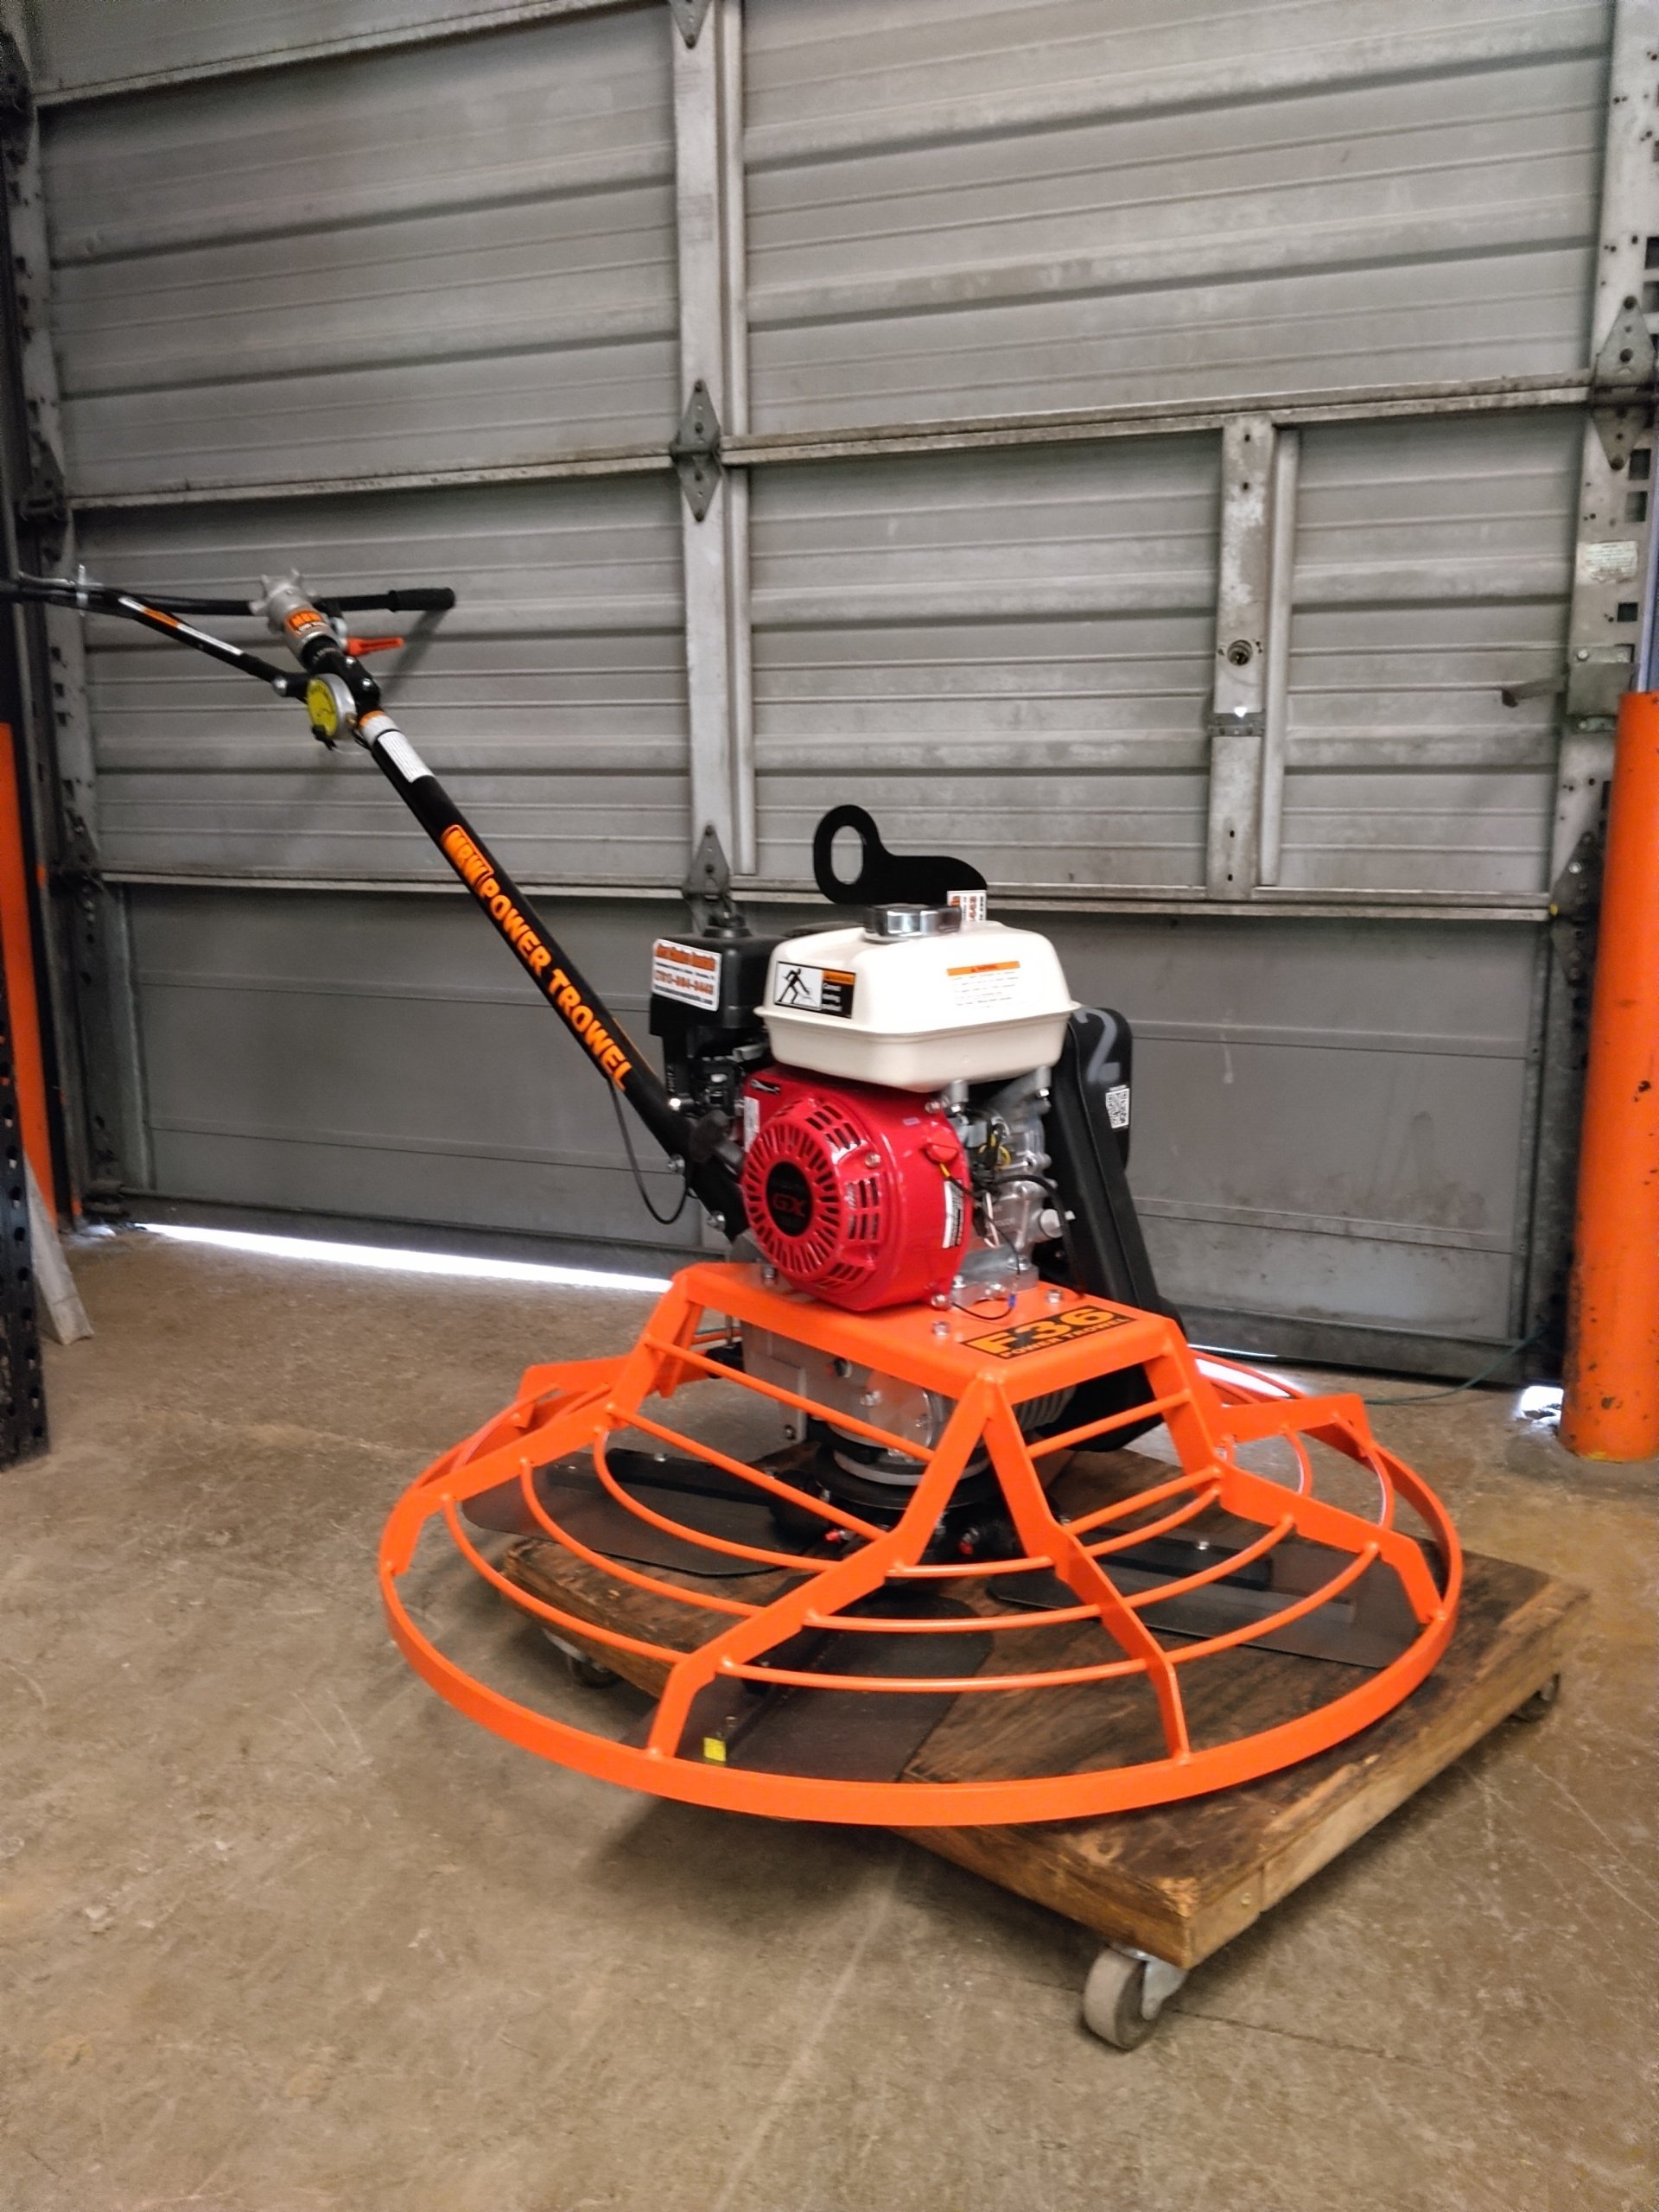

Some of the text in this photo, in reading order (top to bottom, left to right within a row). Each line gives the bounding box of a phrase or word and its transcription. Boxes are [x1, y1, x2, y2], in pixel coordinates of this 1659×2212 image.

[479, 877, 551, 977] POWER
[548, 969, 632, 1092] TROWEL
[964, 1307, 1115, 1354] F36
[1001, 1318, 1130, 1357] POWER TROWEL
